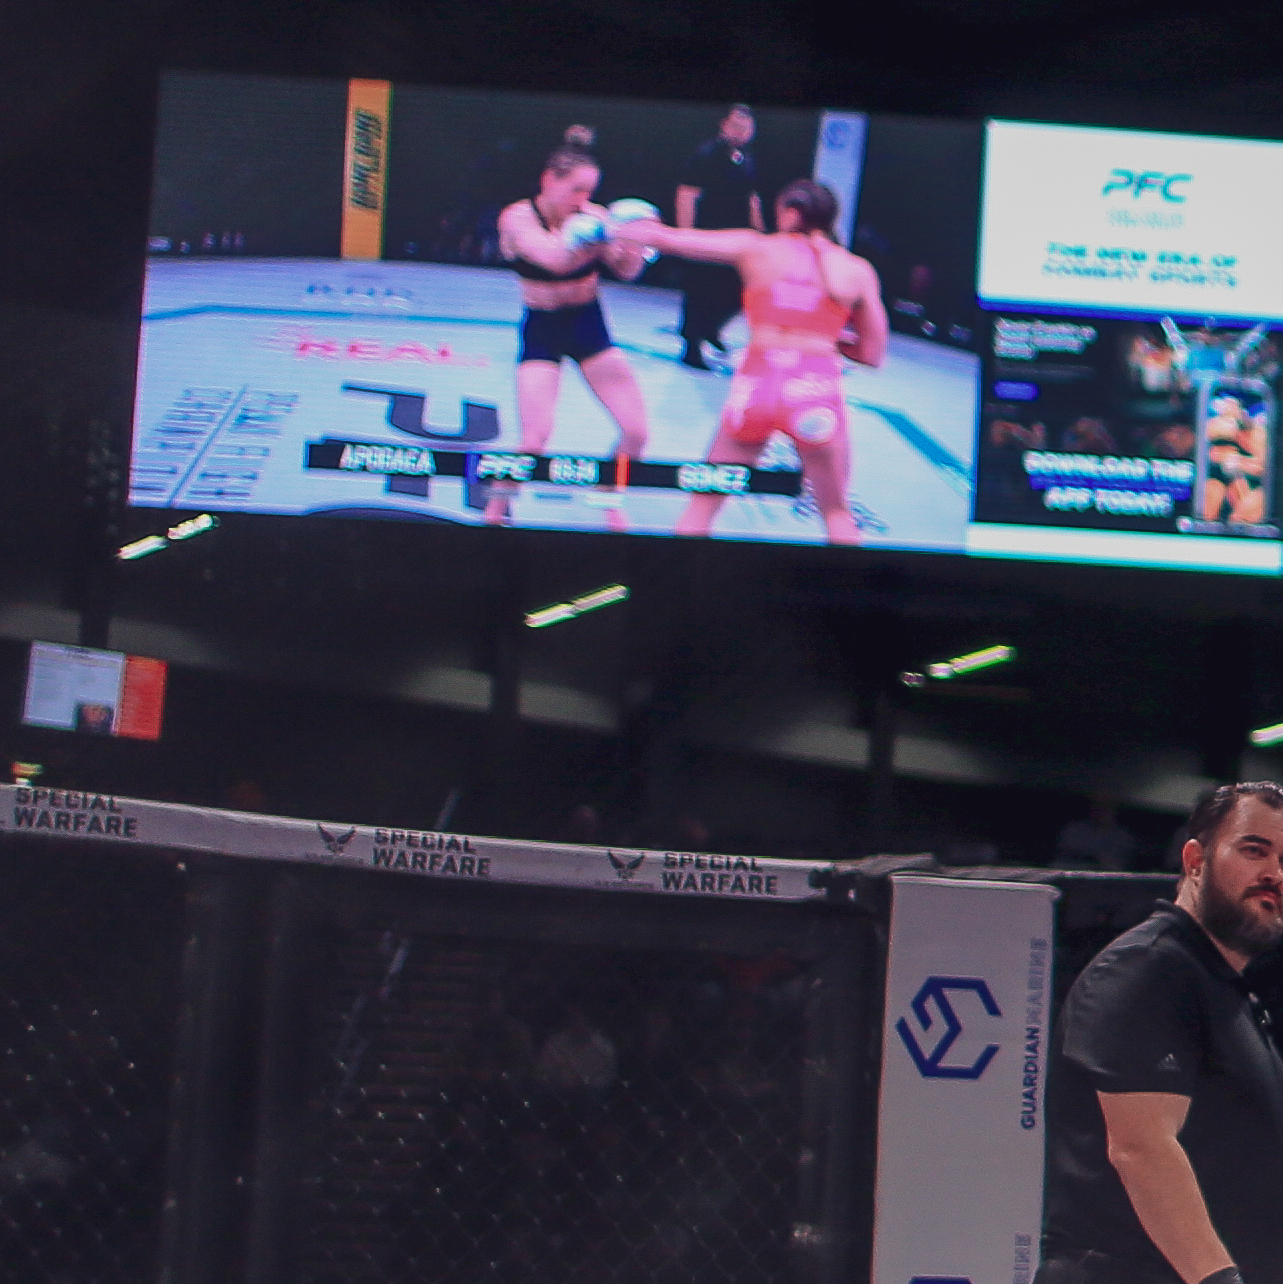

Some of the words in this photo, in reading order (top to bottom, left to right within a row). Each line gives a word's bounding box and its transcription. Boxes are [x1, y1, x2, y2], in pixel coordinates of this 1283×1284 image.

[1101, 167, 1194, 204] PFC
[14, 786, 123, 813] SPECIAL
[12, 807, 138, 839] WARFARE
[373, 828, 478, 854] SPECIAL
[371, 847, 492, 878] WARFARE
[663, 850, 764, 873] SPECIAL
[660, 870, 780, 896] WARFARE
